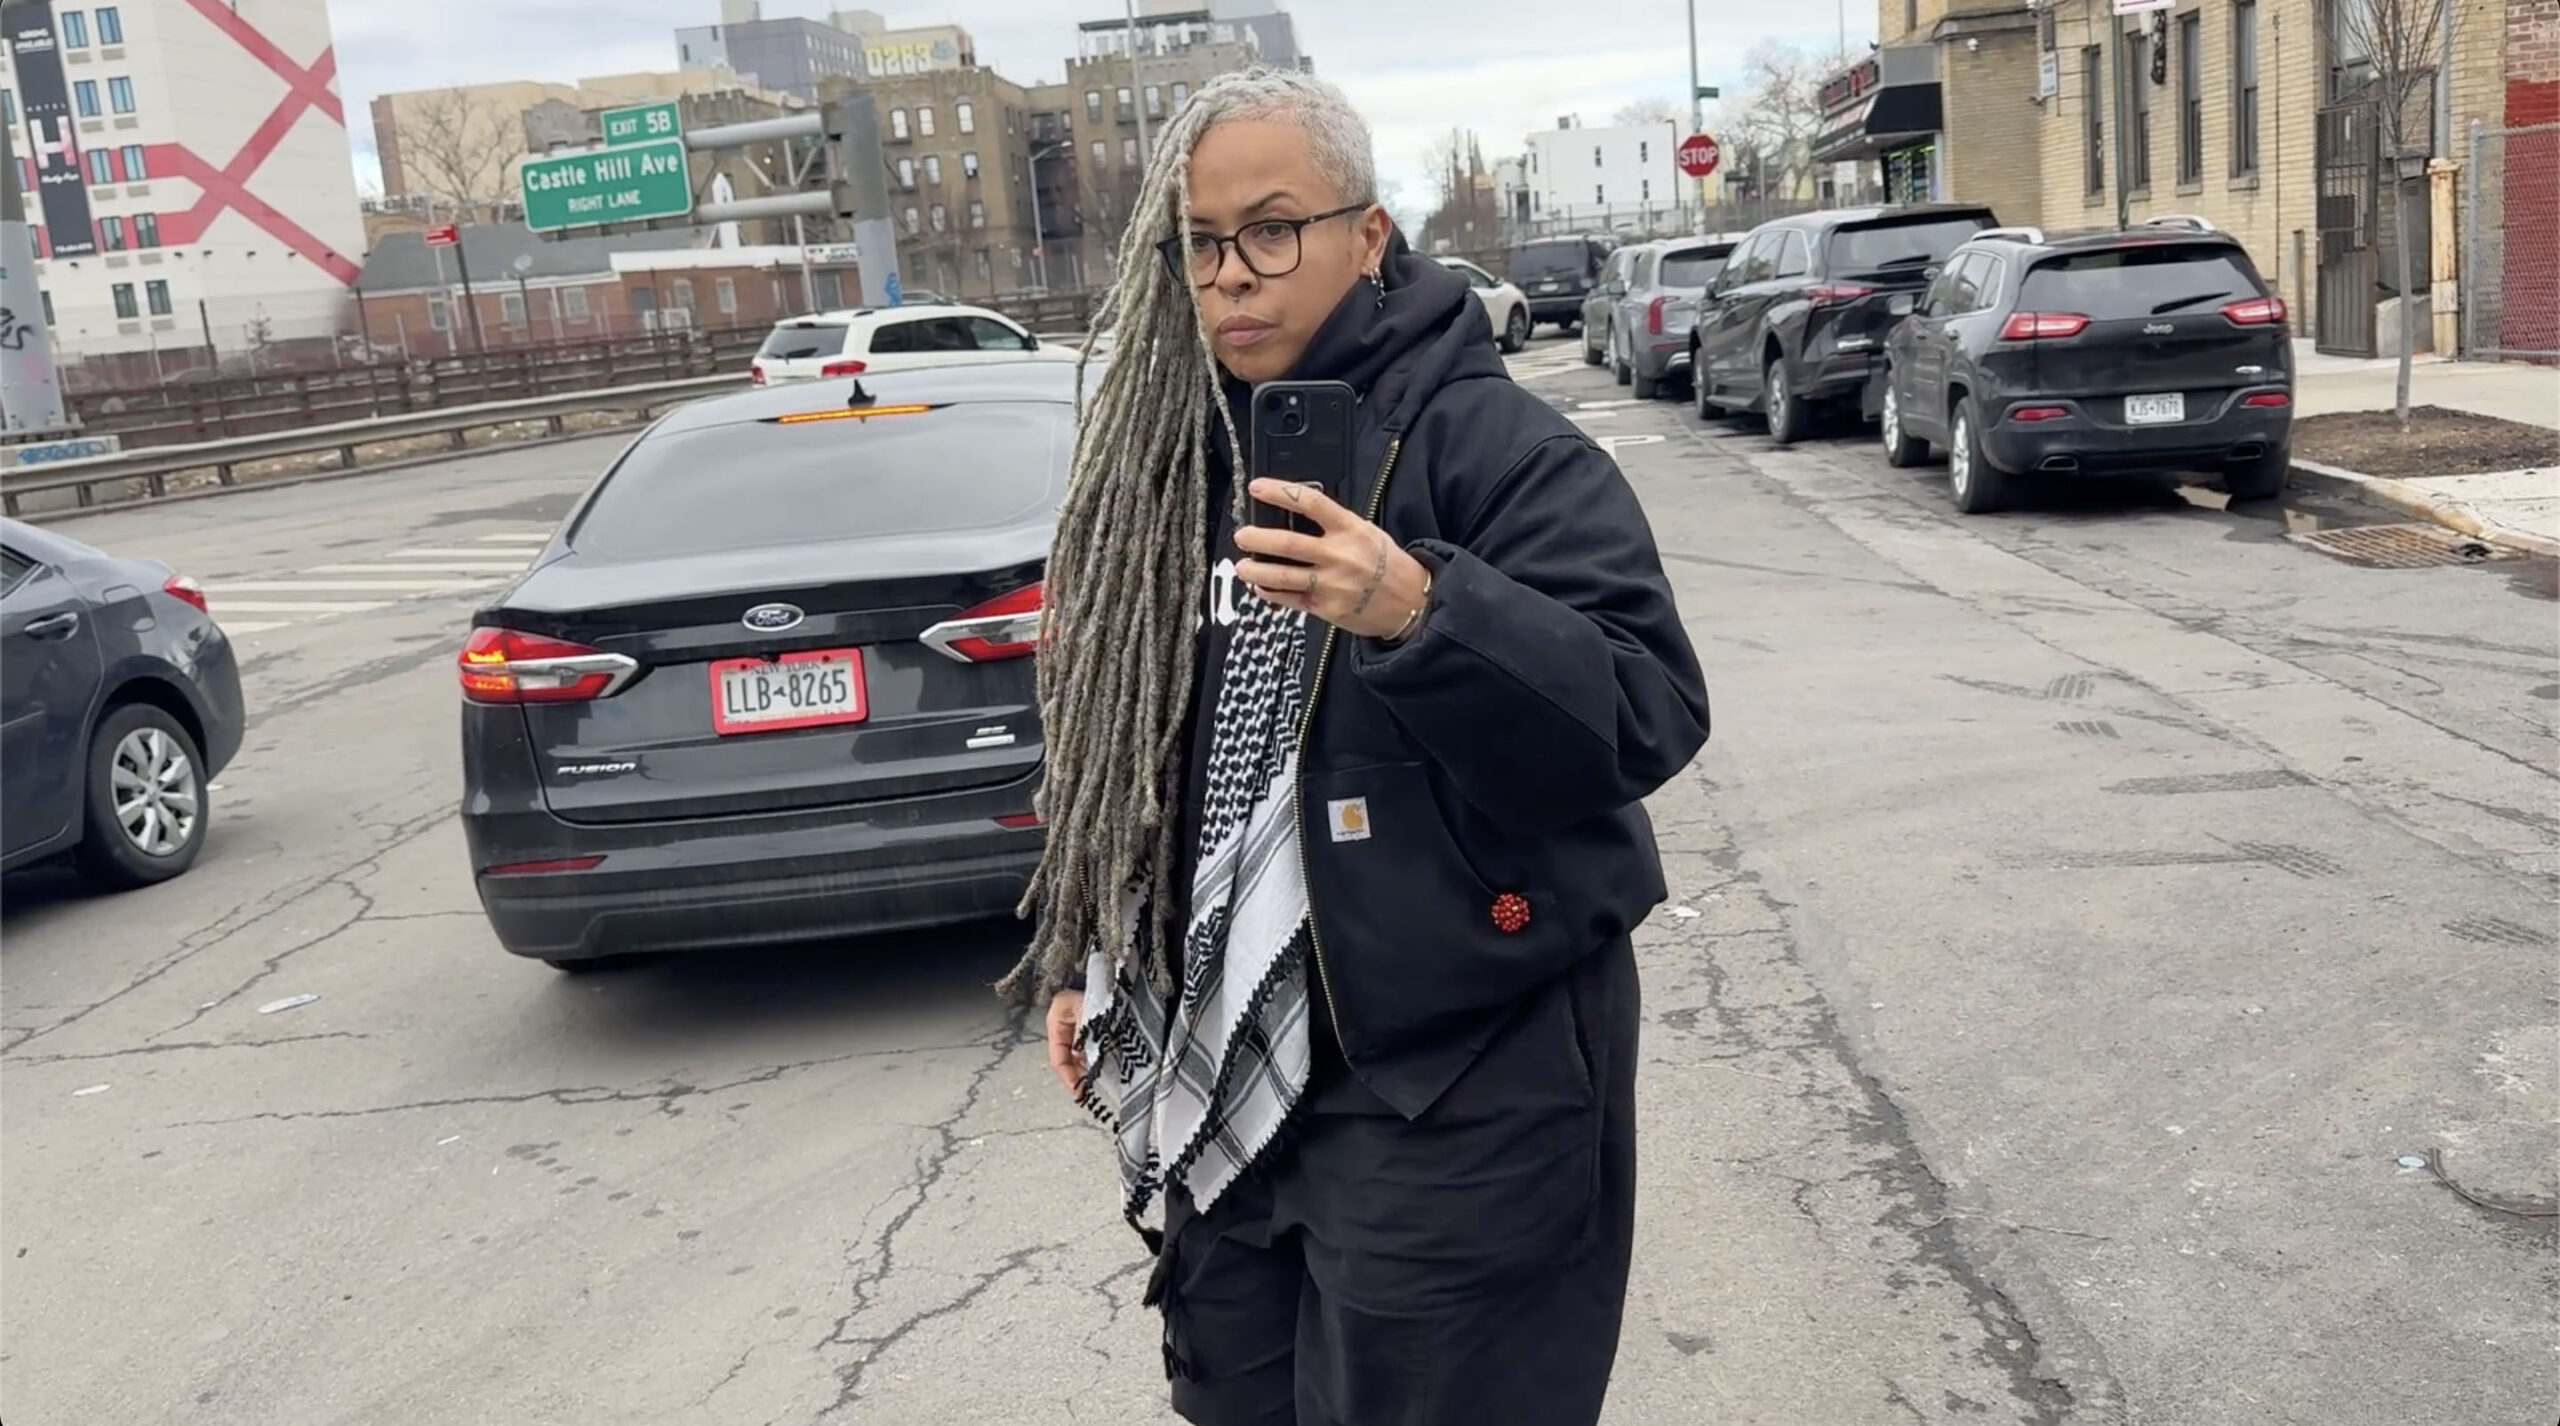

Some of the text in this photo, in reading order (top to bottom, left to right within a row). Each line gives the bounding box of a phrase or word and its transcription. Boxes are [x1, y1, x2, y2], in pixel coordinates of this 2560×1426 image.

[610, 110, 672, 137] EXIT 5B
[30, 115, 77, 170] H
[1679, 146, 1718, 167] STOP
[526, 153, 679, 192] Castle Hill Ave
[567, 189, 642, 213] RIGHT LANE
[750, 658, 821, 676] NEW YORK
